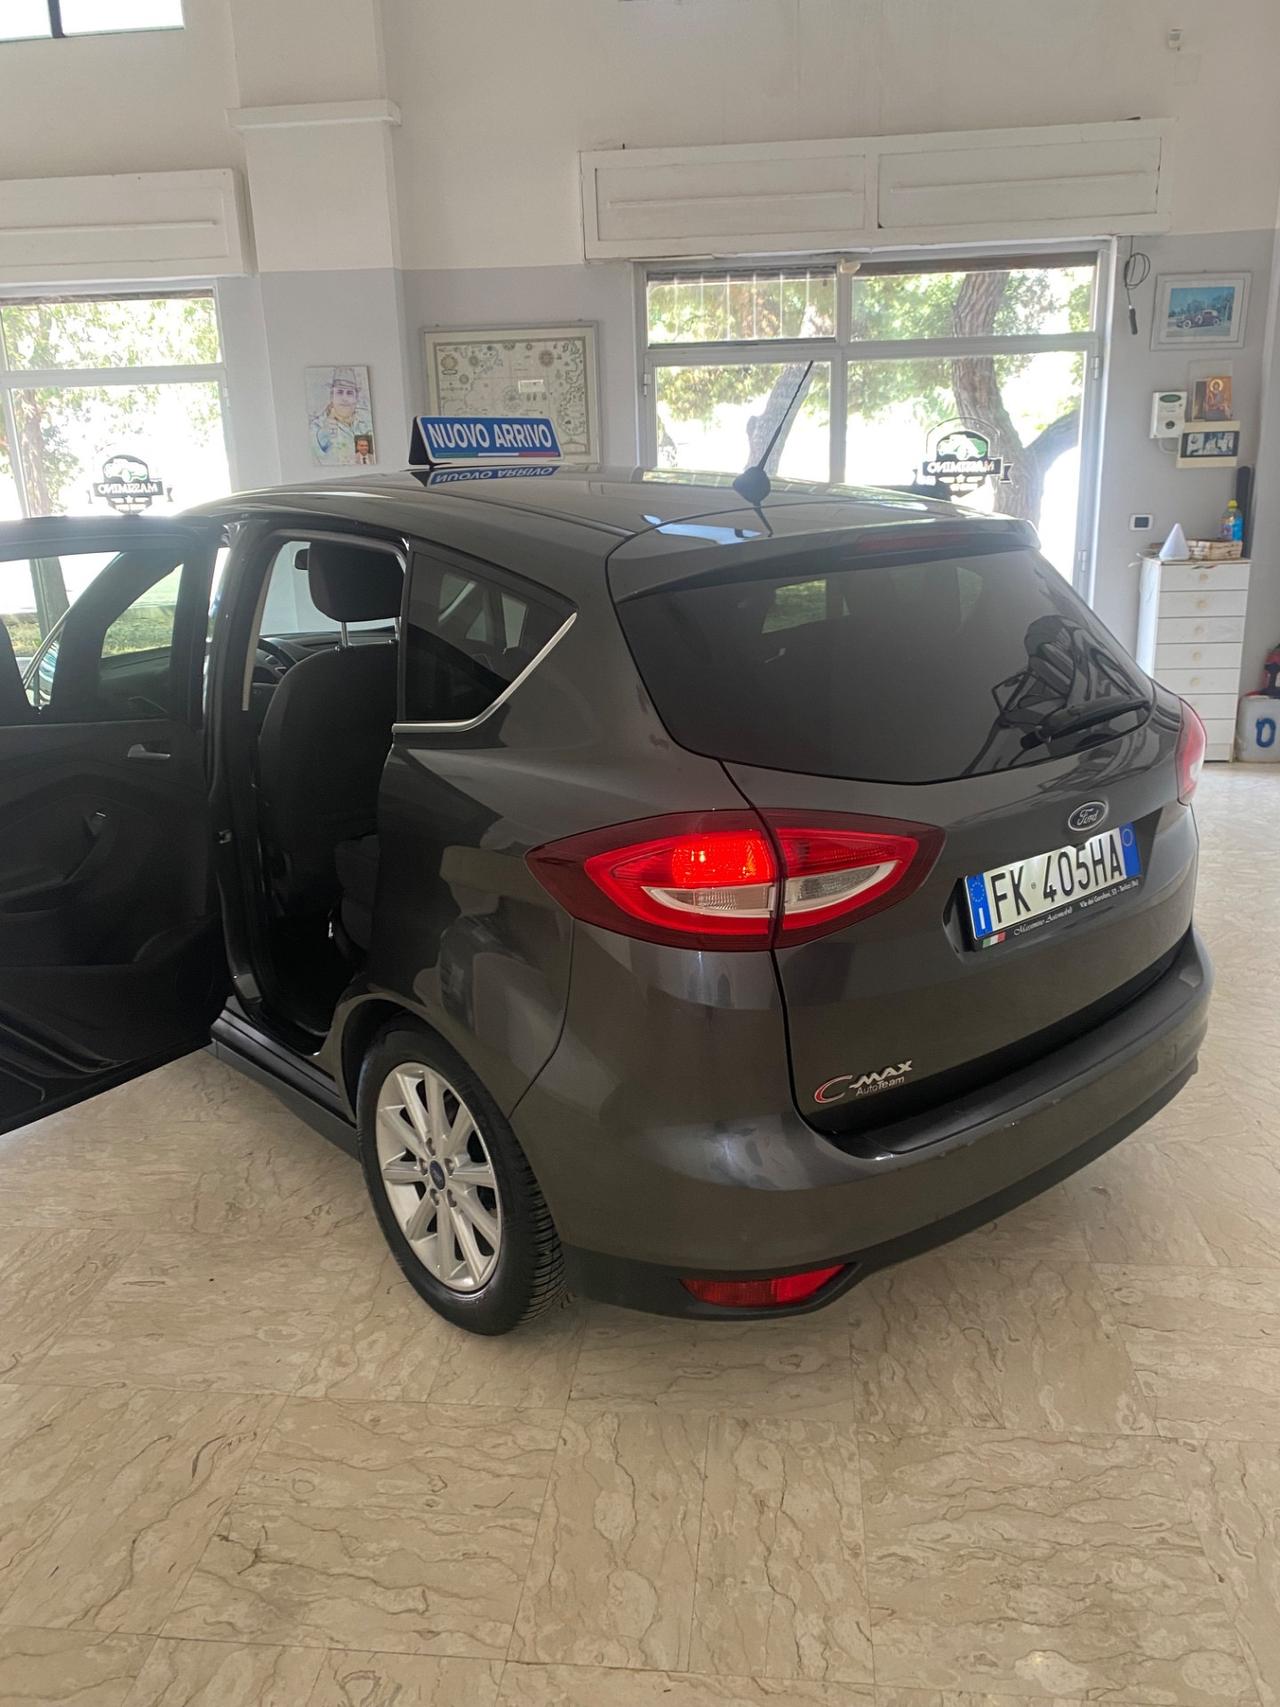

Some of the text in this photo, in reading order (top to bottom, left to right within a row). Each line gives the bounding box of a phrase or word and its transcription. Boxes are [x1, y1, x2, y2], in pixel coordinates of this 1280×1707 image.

[427, 423, 552, 448] NUOVO ARRIVO
[990, 865, 1031, 923] FK
[1043, 834, 1123, 903] 405HA
[856, 1076, 905, 1097] AutoTeam
